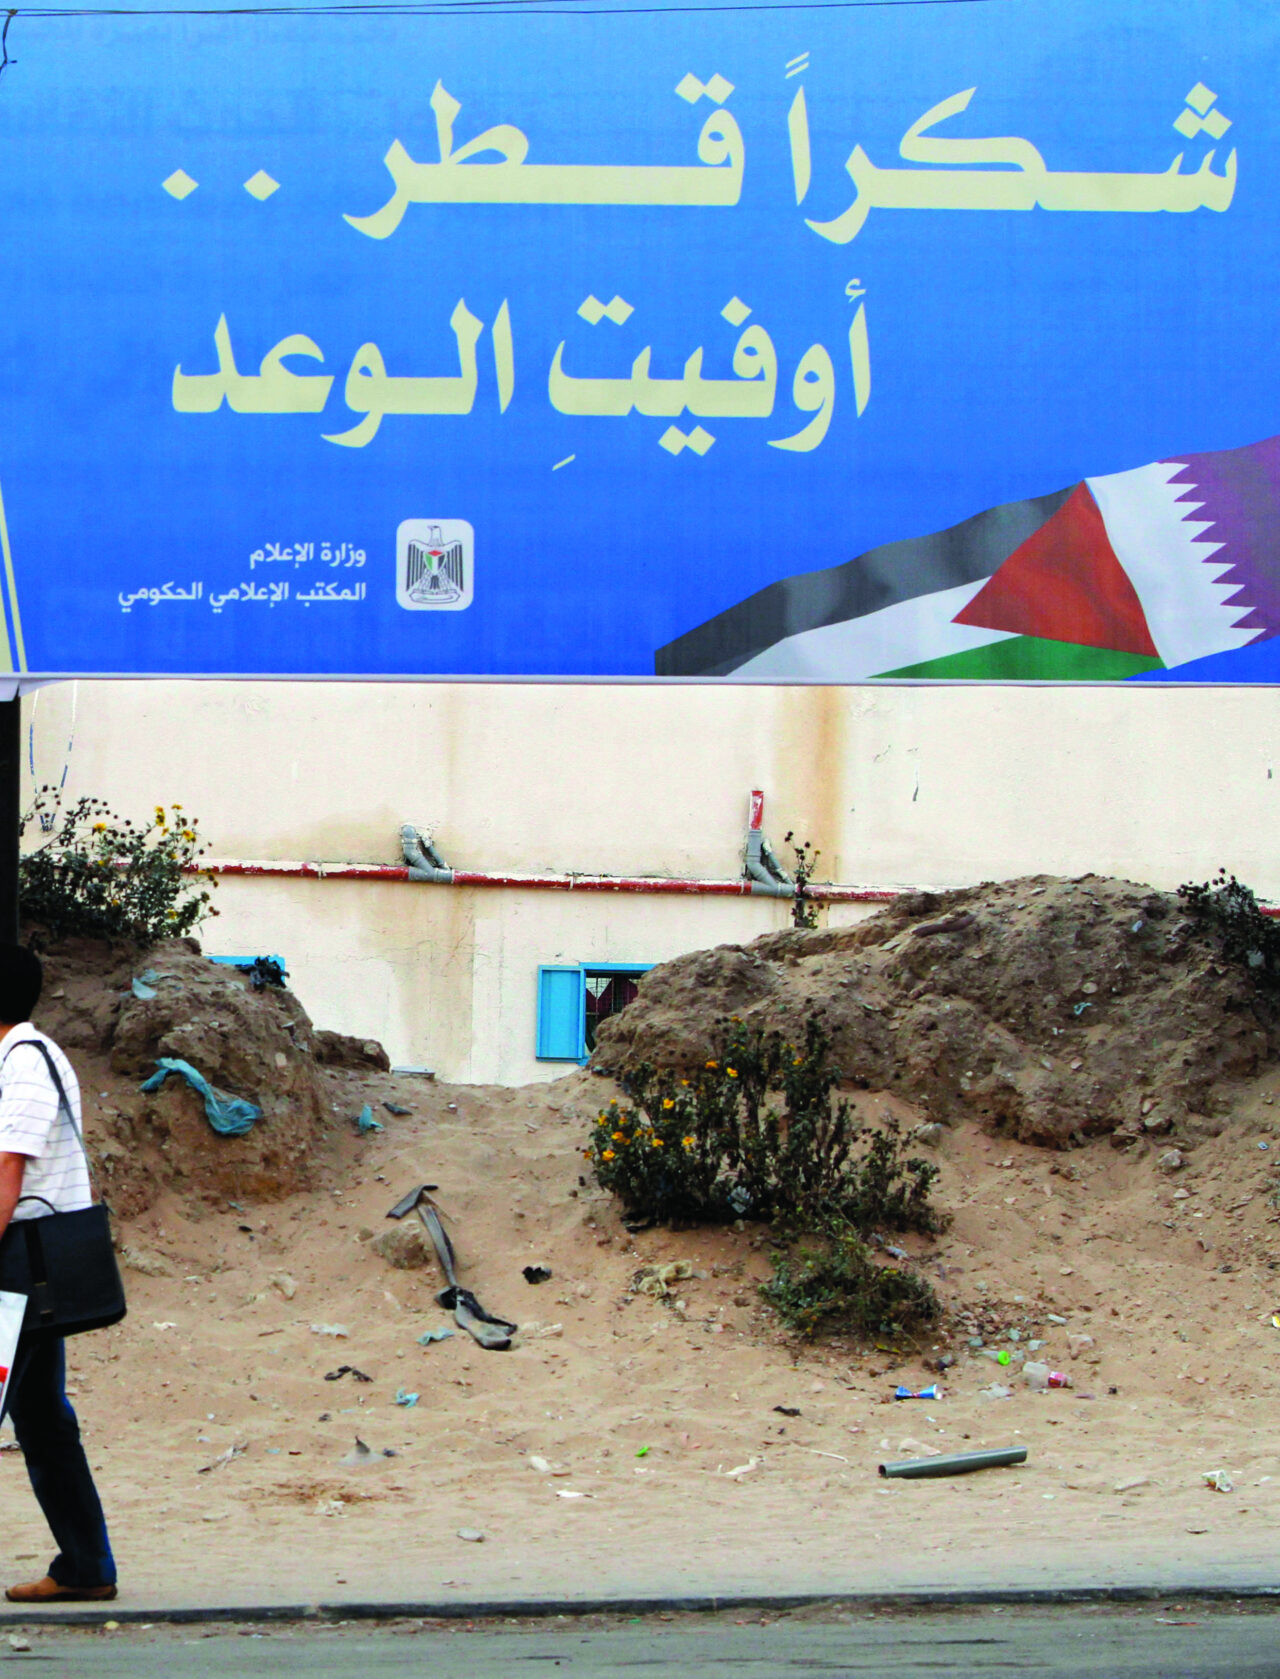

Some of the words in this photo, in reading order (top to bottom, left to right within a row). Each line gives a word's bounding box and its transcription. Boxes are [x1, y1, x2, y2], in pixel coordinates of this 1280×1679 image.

[343, 72, 746, 240] قطر
[171, 297, 516, 449] الوعد
[250, 542, 314, 569] الإعلام
[321, 542, 367, 567] وزارة
[118, 581, 203, 612] الحكومي
[209, 582, 289, 613] الإعلامي
[296, 582, 367, 607] المكتب
